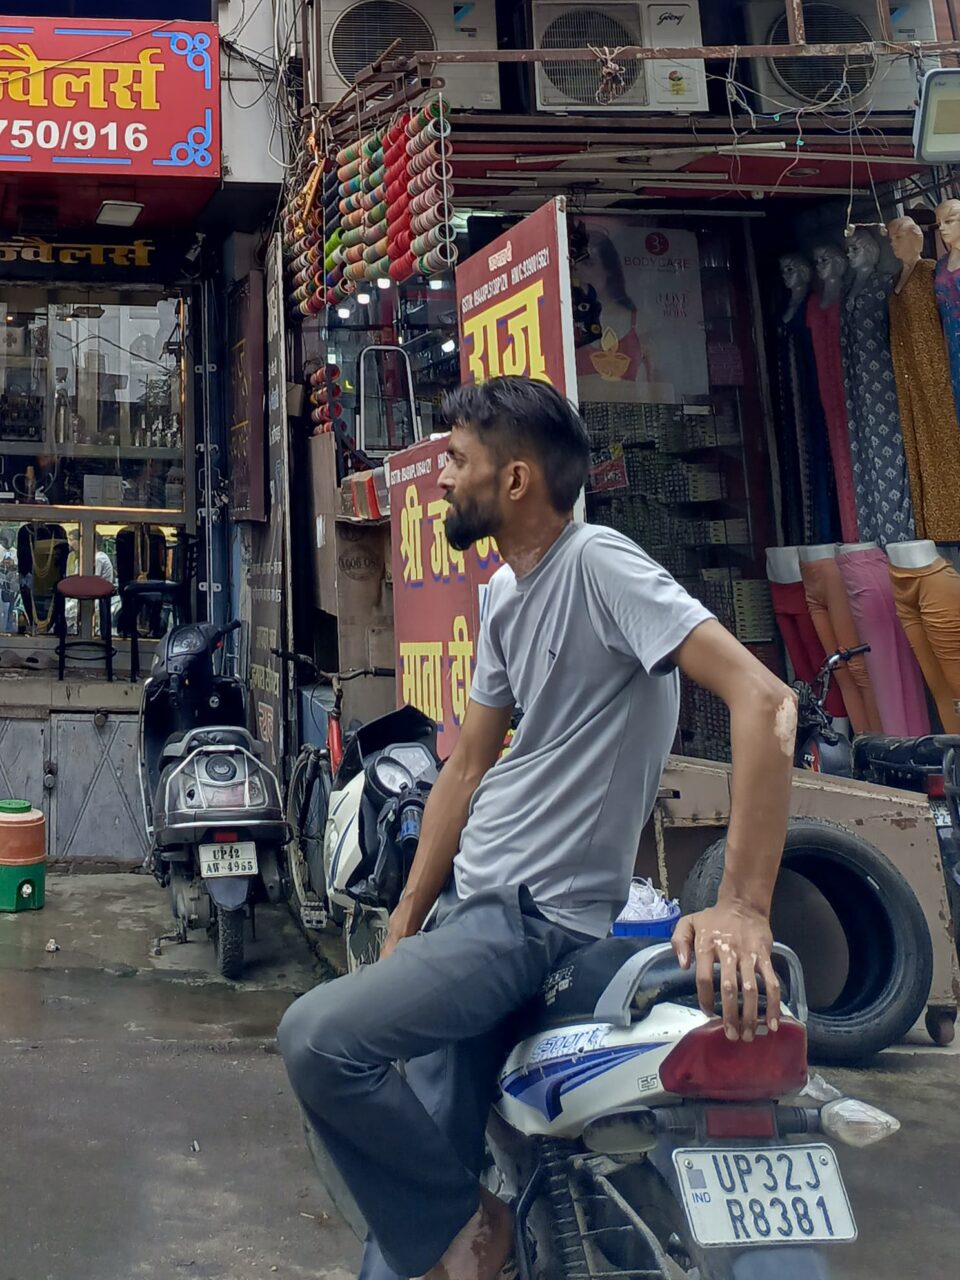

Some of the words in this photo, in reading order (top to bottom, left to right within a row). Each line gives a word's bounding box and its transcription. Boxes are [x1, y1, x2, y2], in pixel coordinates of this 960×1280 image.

[400, 484, 424, 583] श्री
[399, 642, 444, 722] माता
[448, 616, 473, 725] दी
[711, 1152, 821, 1193] UP32J
[692, 1192, 711, 1203] IND
[726, 1195, 834, 1239] R8381
